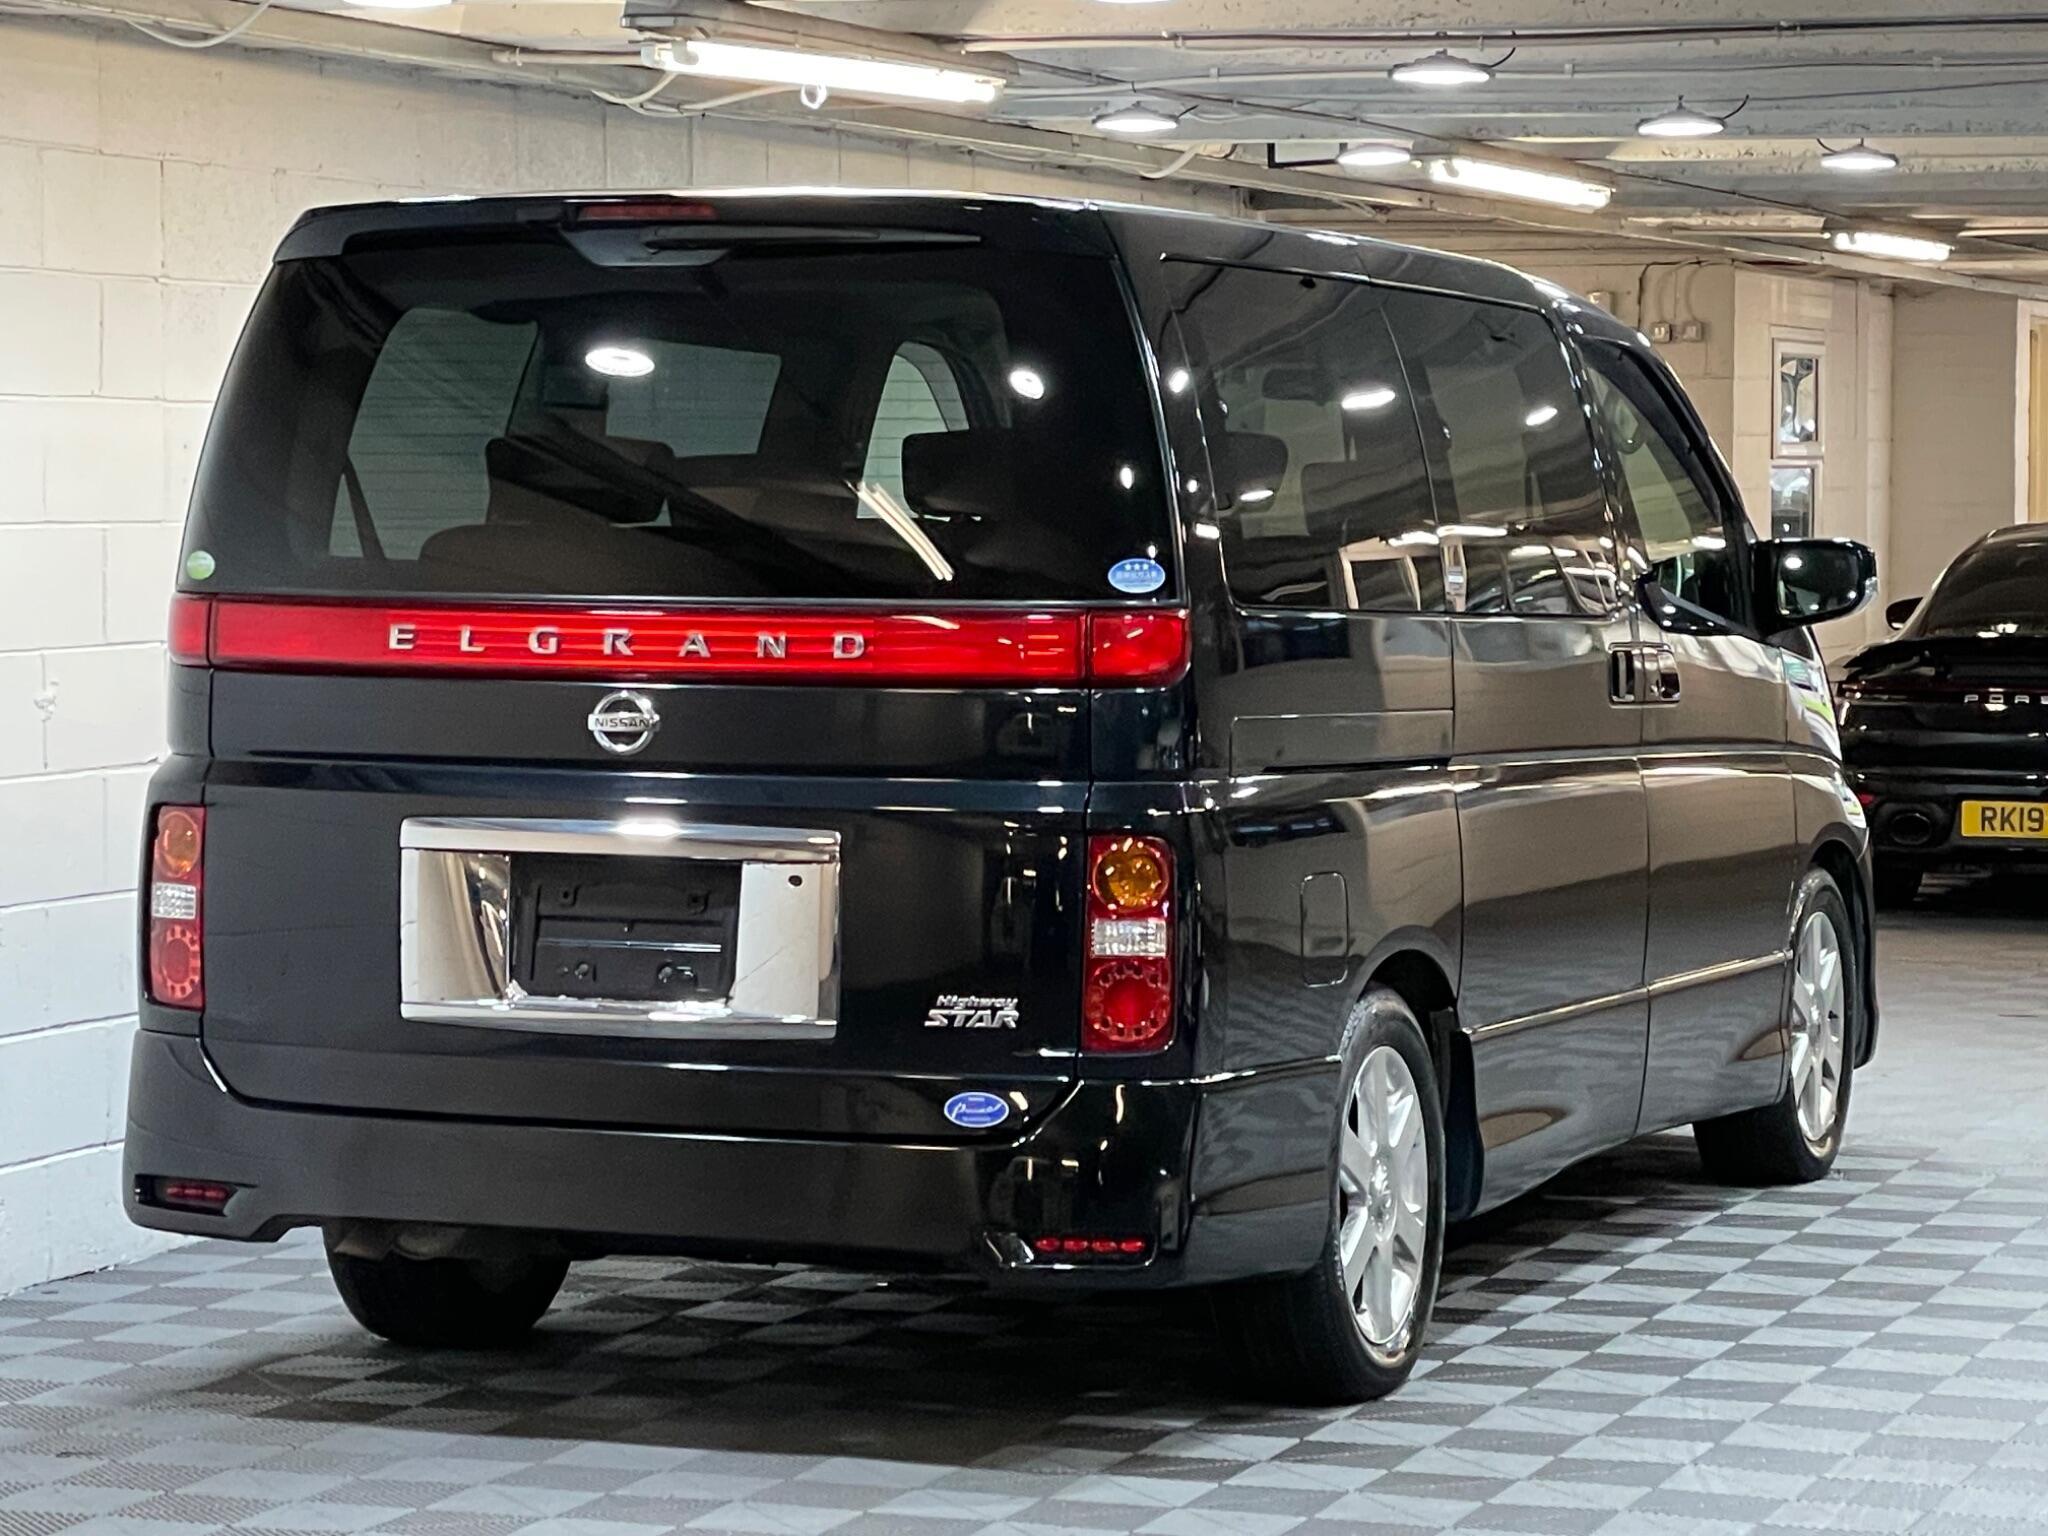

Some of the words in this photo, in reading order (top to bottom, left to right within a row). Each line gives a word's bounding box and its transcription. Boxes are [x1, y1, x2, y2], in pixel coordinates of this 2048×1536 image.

[389, 624, 864, 658] ELGRAND
[595, 717, 650, 729] NISSAN
[1981, 806, 2044, 832] RK19
[924, 1009, 1019, 1027] STAR
